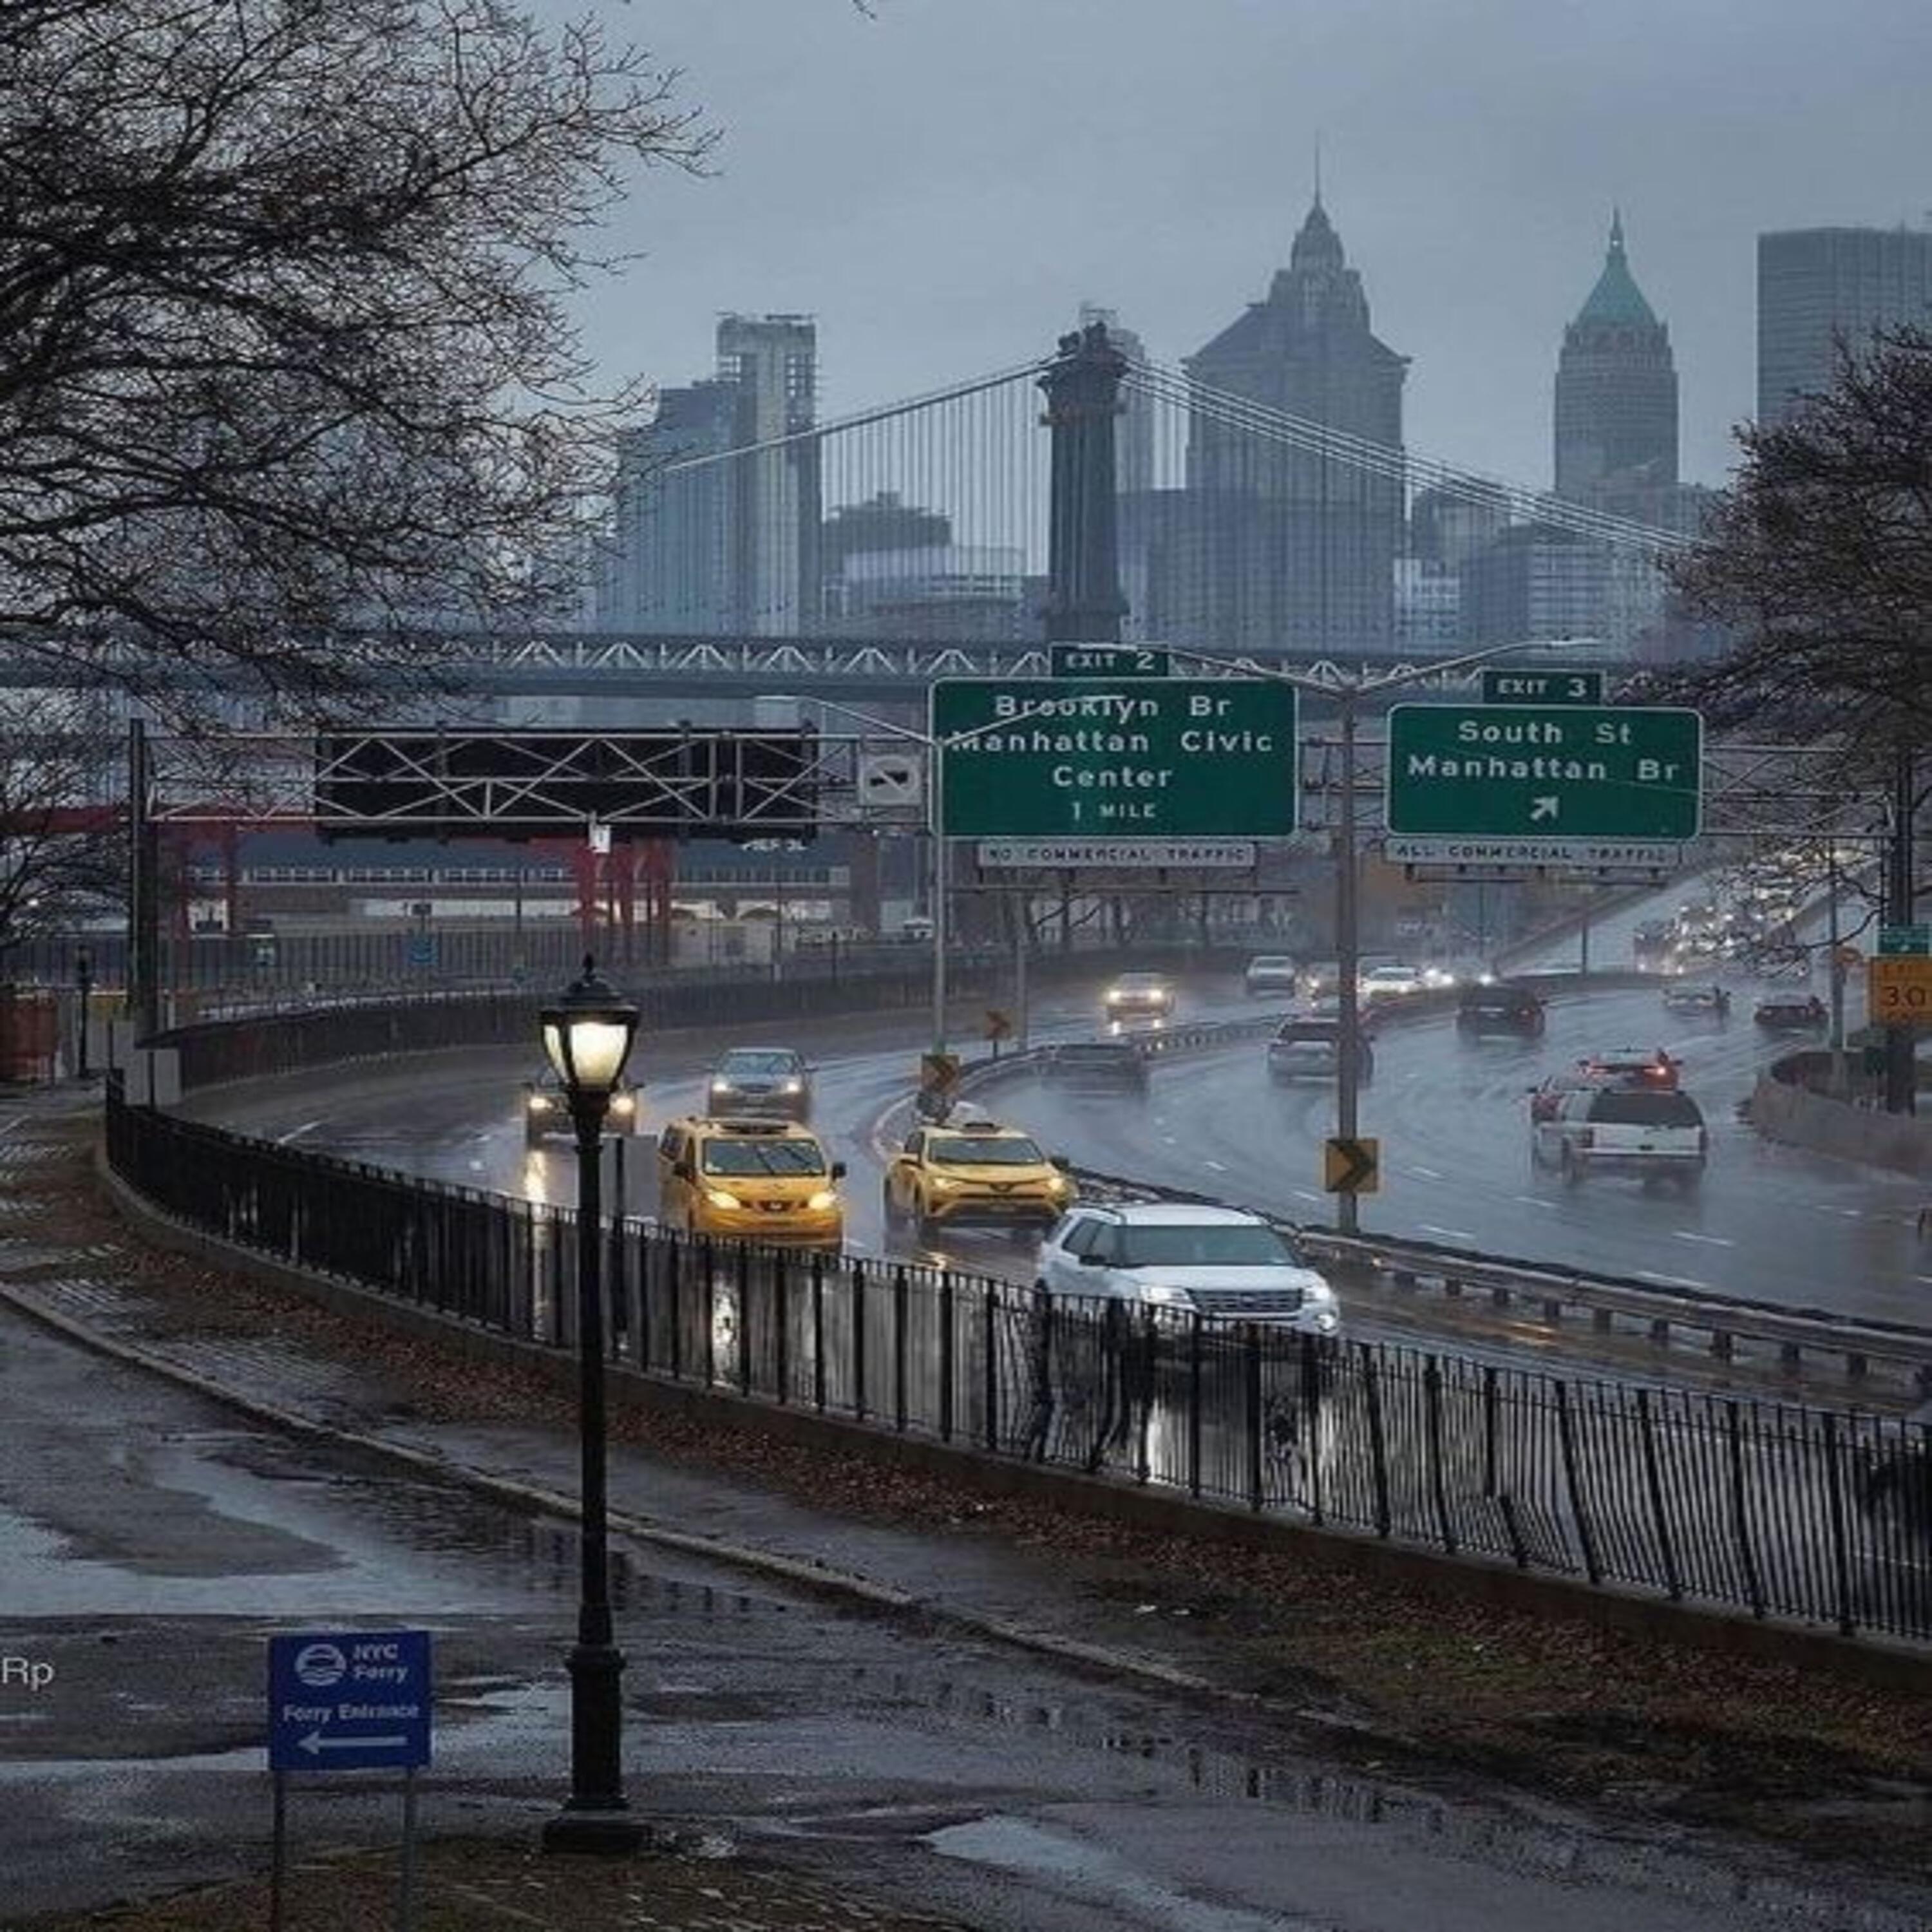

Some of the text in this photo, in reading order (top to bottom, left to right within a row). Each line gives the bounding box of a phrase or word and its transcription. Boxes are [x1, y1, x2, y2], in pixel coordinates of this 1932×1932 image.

[1066, 650, 1155, 669] EXIT 2
[1497, 678, 1586, 696] EXIT 3
[996, 696, 1232, 724] Brooklyn Br
[1180, 731, 1273, 752] Civic
[1458, 721, 1632, 744] South St
[1052, 766, 1173, 788] Center
[1408, 755, 1681, 781] Manhattan Br
[1072, 802, 1157, 820] 1 MILE
[1397, 846, 1434, 857] ALL
[1448, 846, 1572, 859] COMMERCIAL
